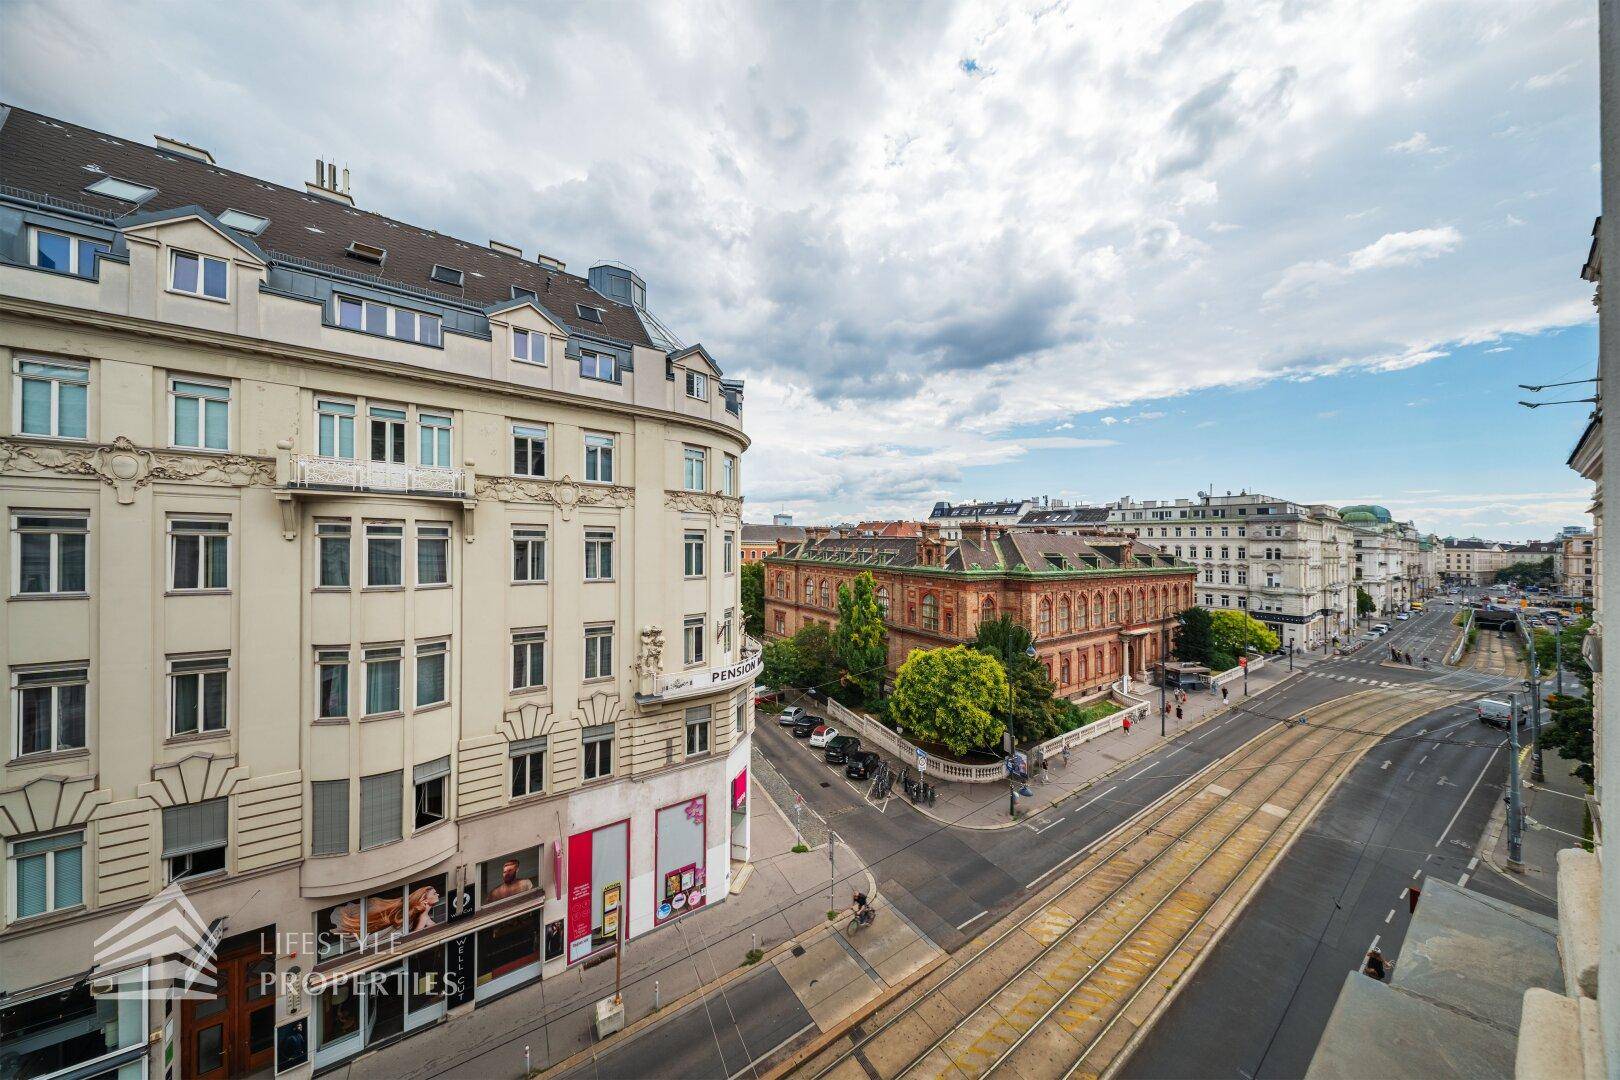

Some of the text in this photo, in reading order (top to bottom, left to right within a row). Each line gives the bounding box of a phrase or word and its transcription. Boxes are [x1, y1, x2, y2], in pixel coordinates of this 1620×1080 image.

[711, 660, 756, 682] PENSION
[456, 937, 467, 1000] WELL CUT
